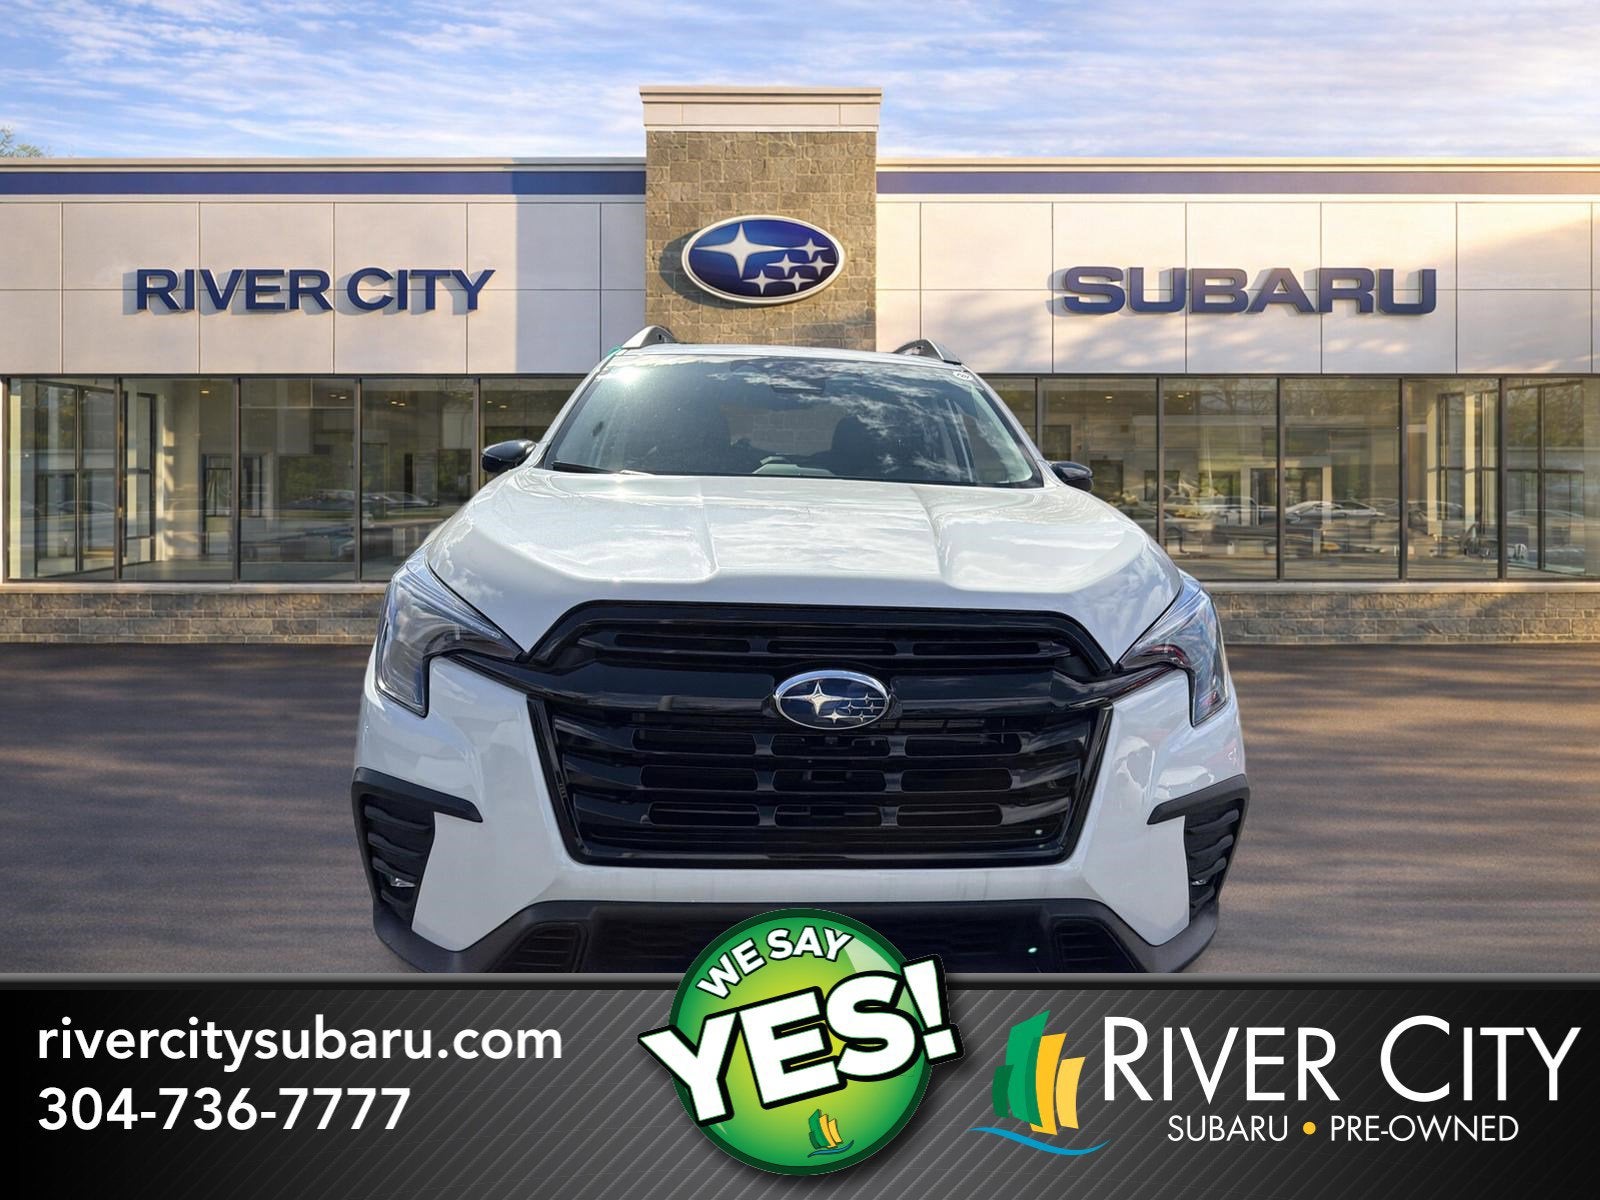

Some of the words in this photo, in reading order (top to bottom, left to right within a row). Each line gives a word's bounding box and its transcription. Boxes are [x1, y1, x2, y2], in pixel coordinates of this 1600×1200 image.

[136, 268, 333, 311] RIVER
[347, 267, 496, 311] CITY
[1062, 266, 1437, 315] SUBARU
